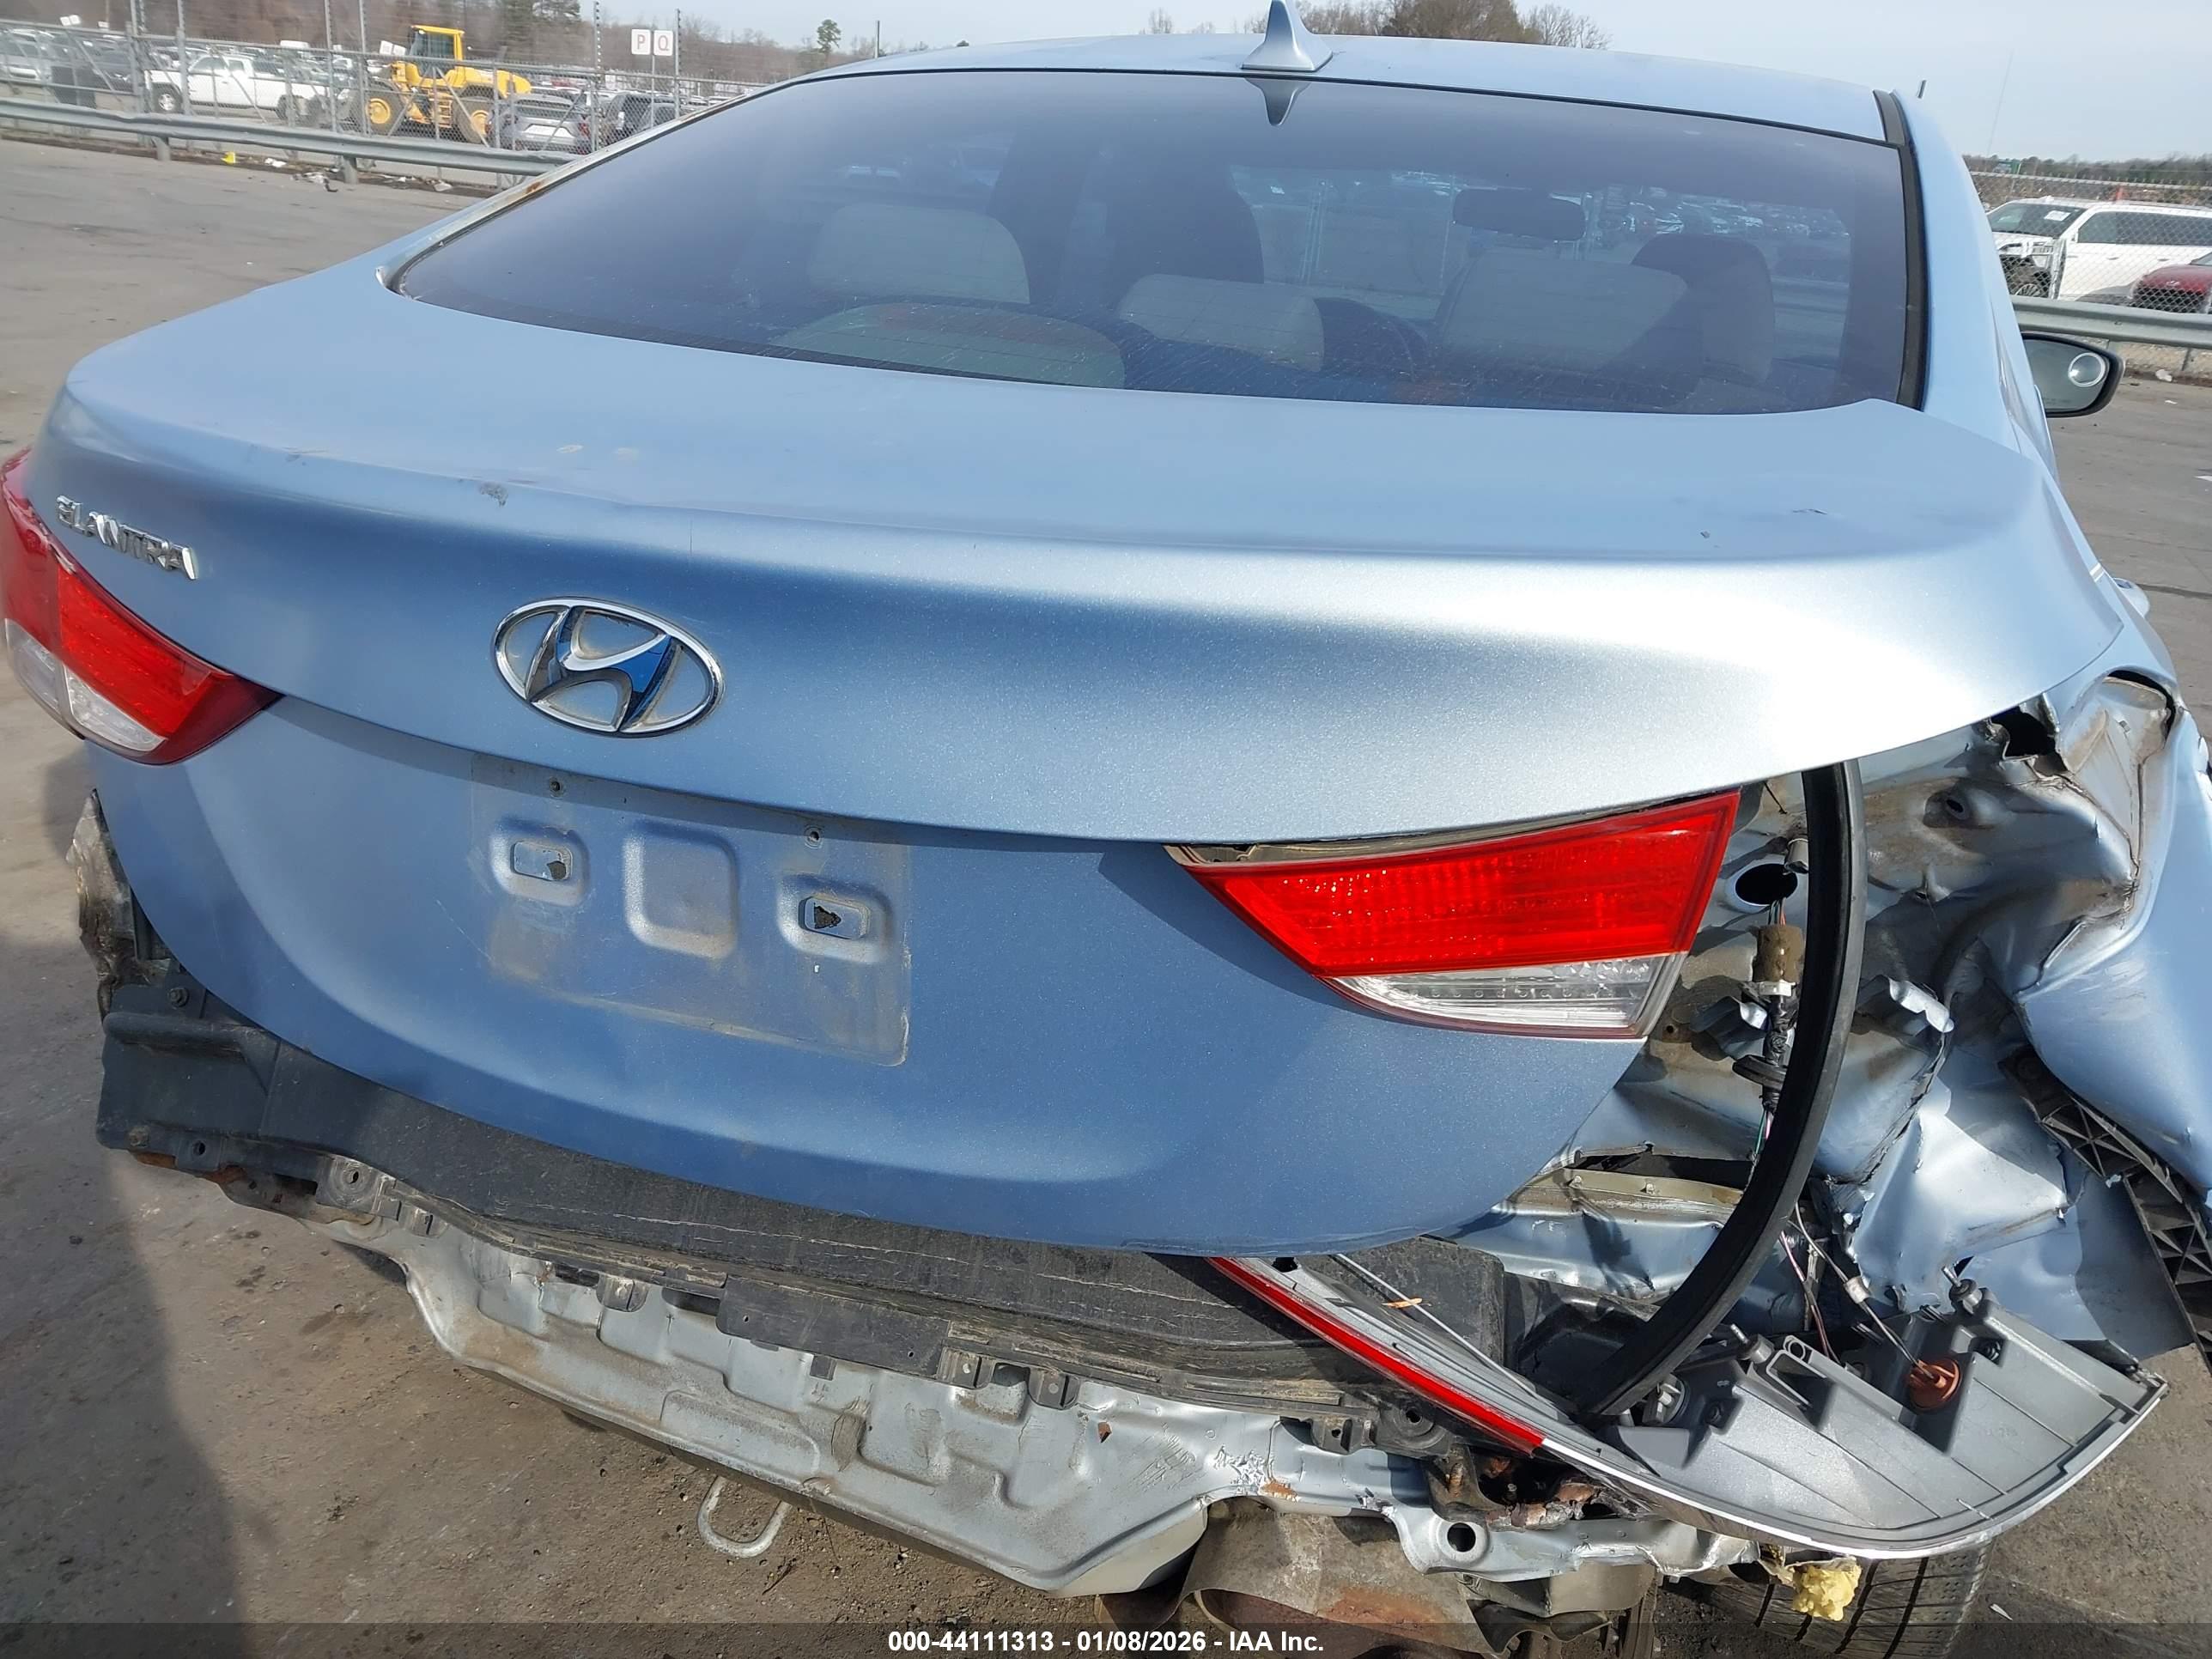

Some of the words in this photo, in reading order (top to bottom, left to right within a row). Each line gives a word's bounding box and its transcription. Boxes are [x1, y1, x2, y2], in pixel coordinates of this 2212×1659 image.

[636, 33, 647, 50] P
[658, 34, 670, 52] Q
[55, 494, 199, 580] ELANTRA
